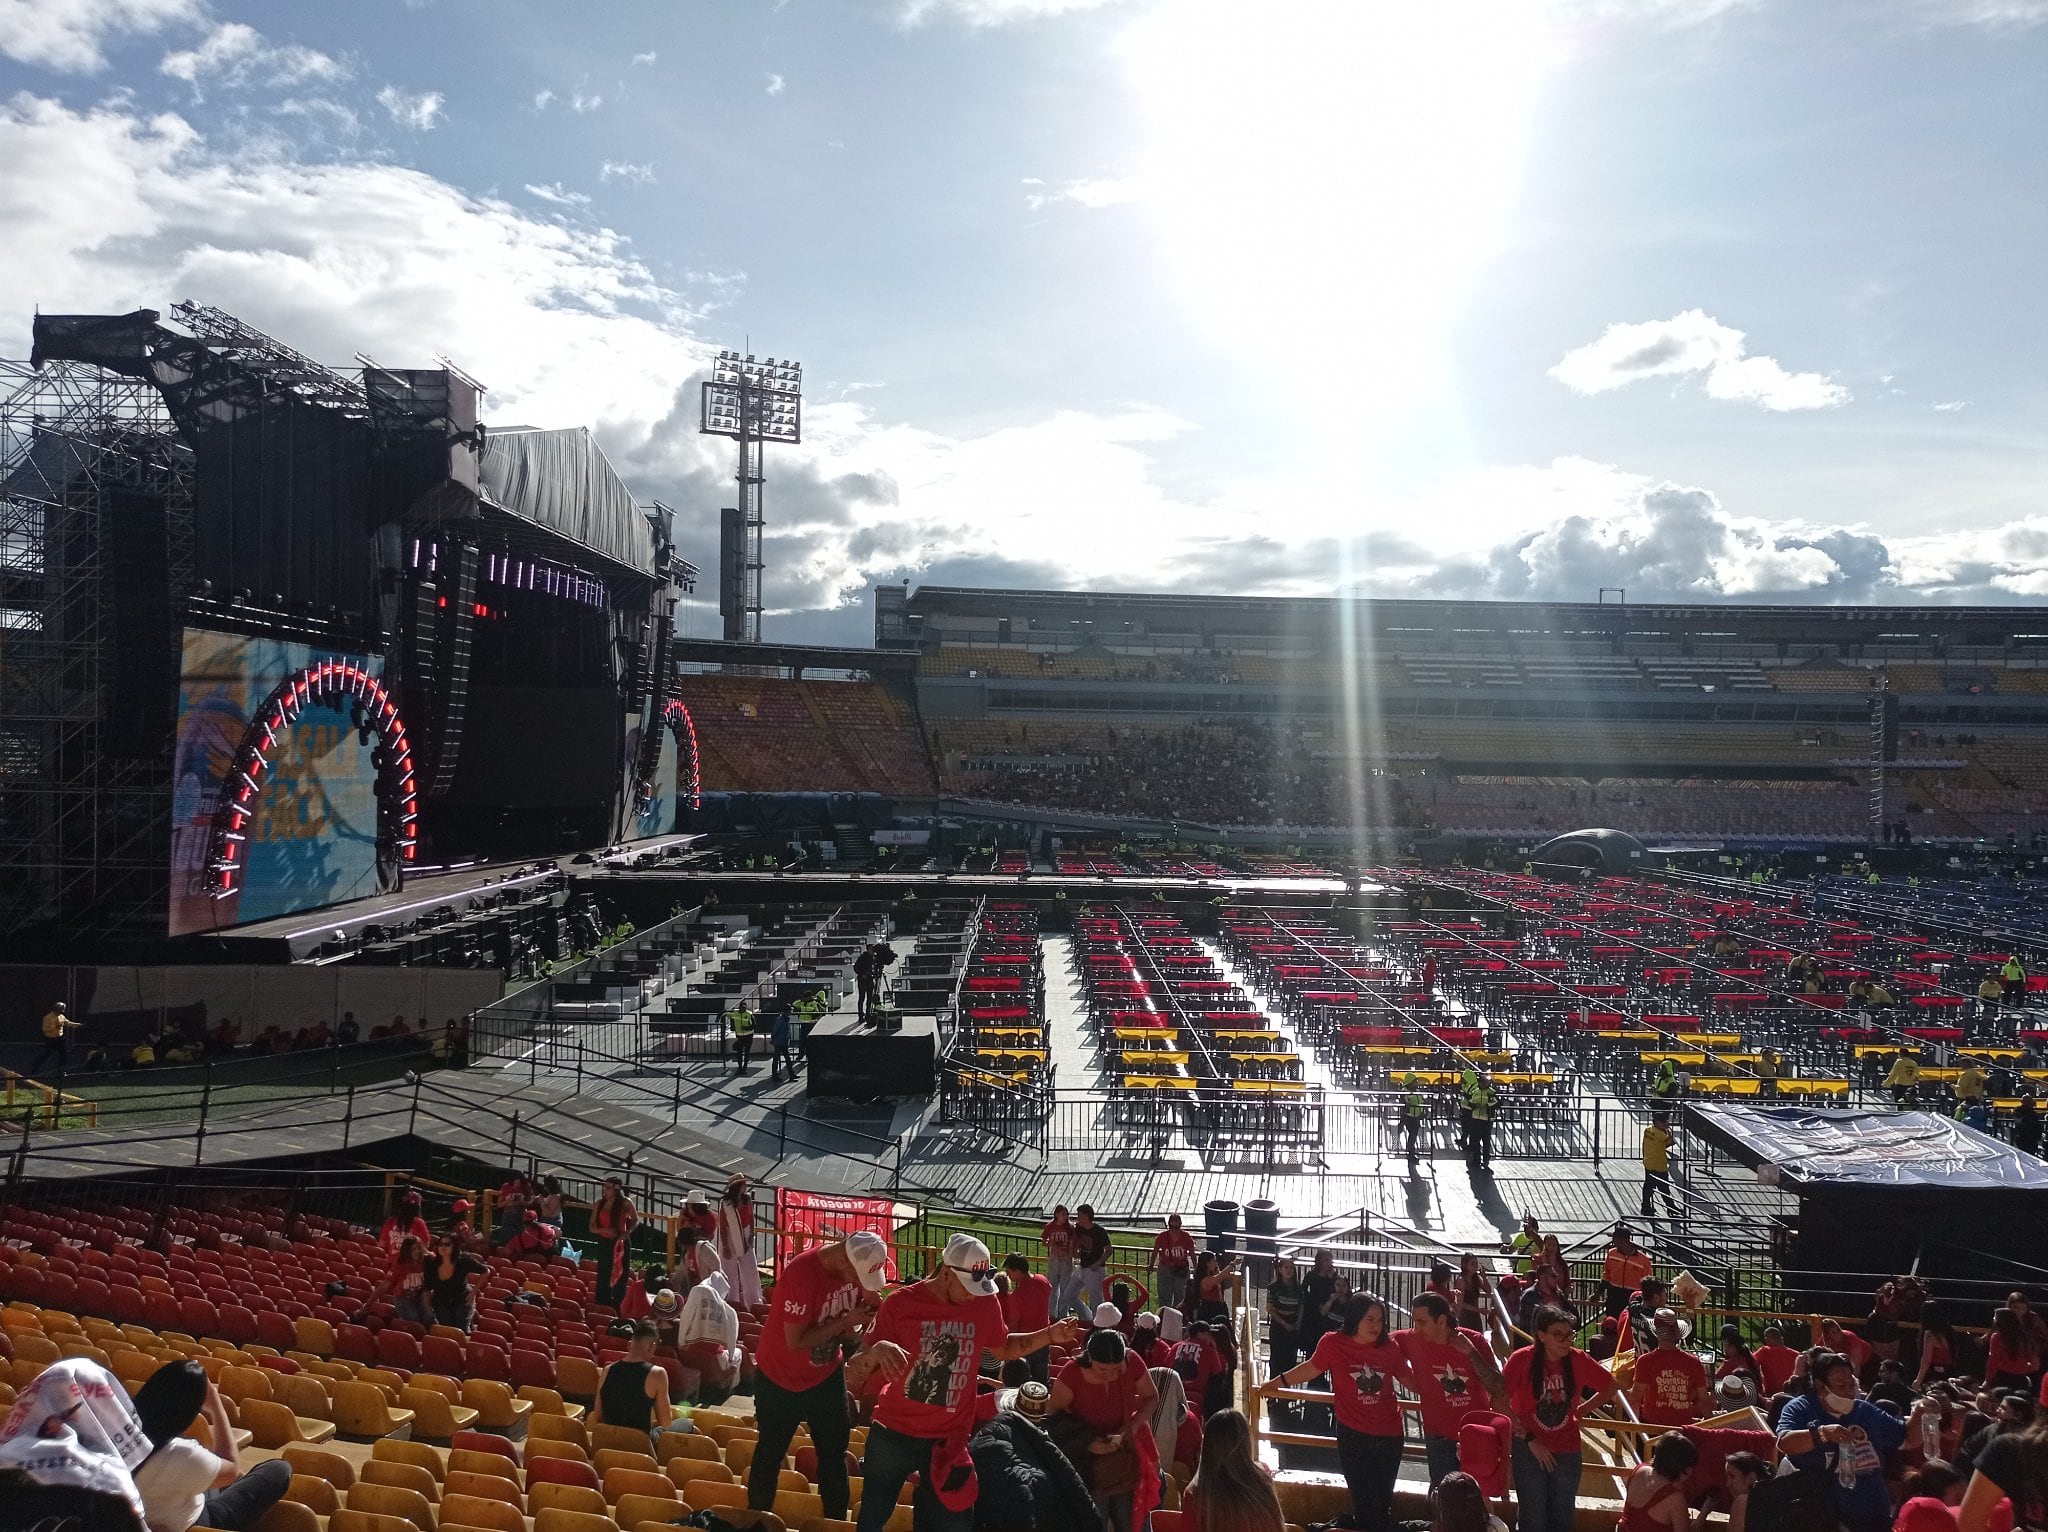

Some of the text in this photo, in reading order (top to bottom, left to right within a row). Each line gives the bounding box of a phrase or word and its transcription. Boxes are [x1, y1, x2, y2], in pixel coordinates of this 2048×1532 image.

[920, 1321, 976, 1339] TA MALO
[1661, 1368, 1674, 1378] ME
